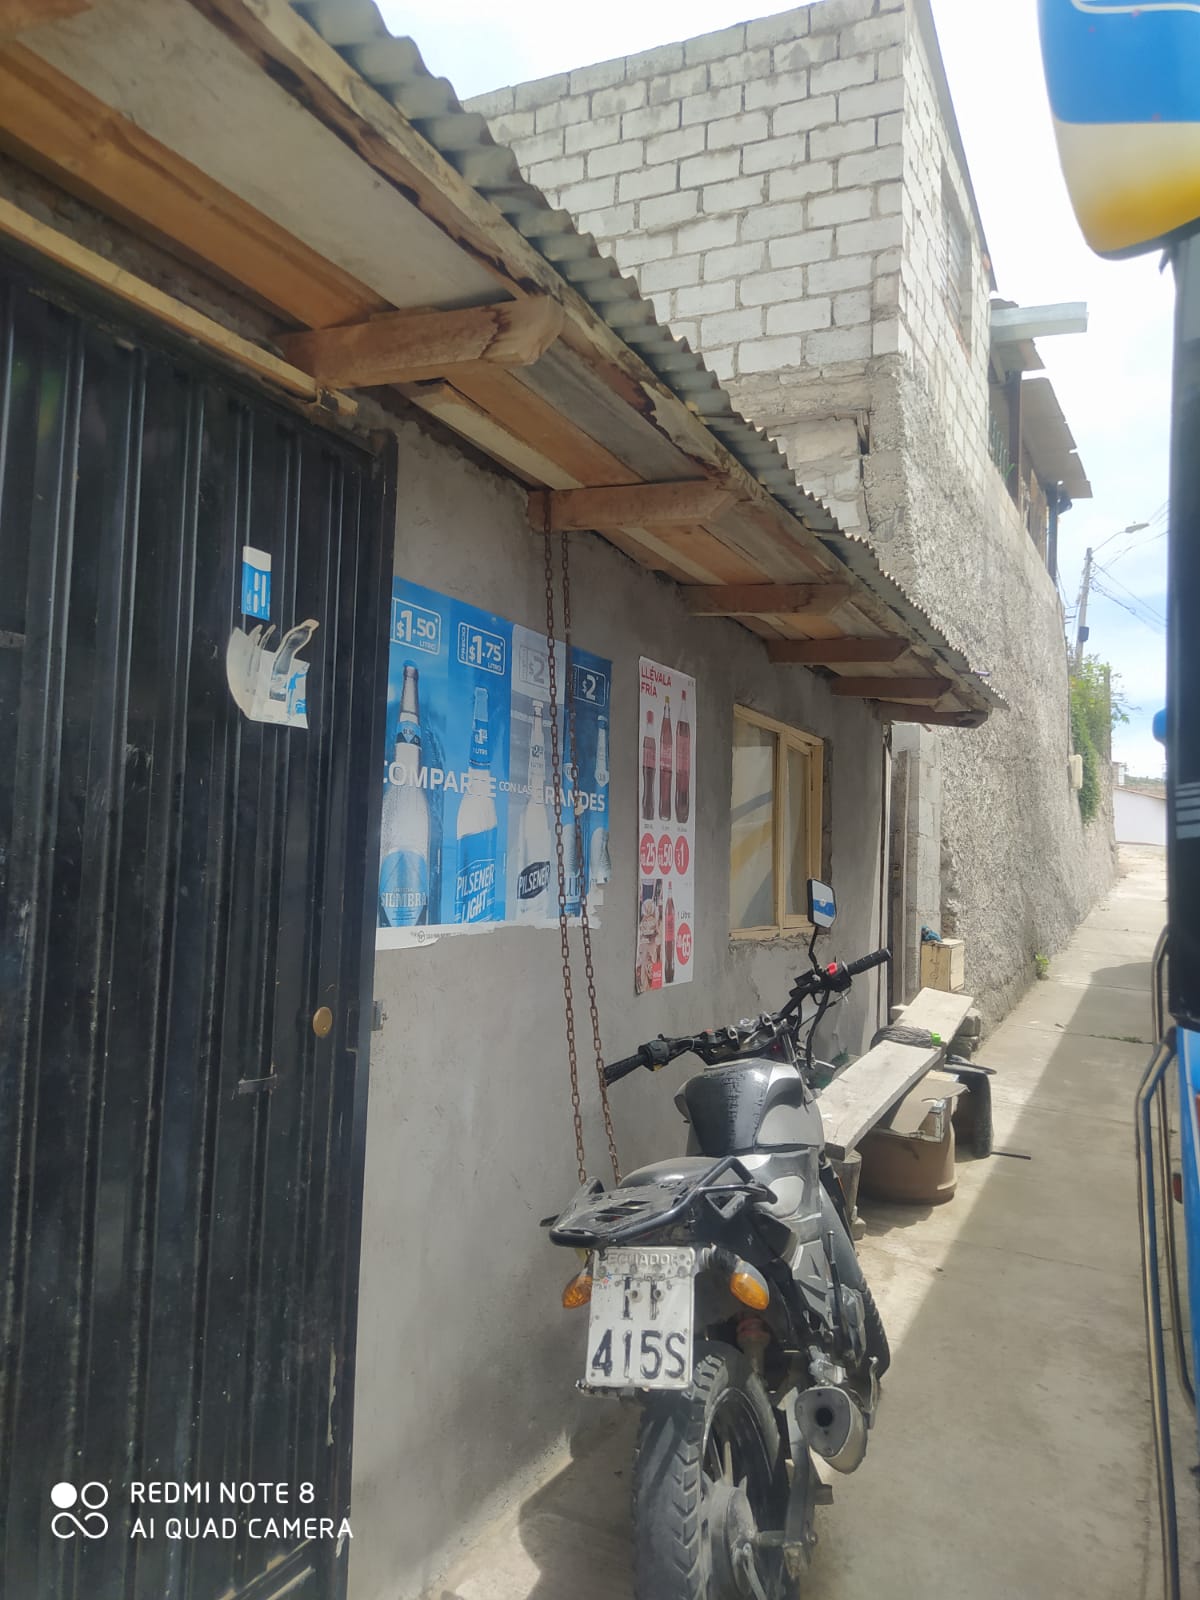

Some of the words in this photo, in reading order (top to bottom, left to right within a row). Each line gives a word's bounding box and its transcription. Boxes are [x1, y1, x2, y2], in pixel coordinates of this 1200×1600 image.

[487, 662, 502, 672] LITRO
[641, 665, 671, 687] LLÉVALA
[640, 681, 657, 698] FRÍA
[499, 781, 517, 793] CON
[456, 864, 495, 900] PILSENER
[519, 864, 550, 898] PILSENER
[461, 889, 489, 924] LIGHT
[592, 1328, 687, 1380] 415S
